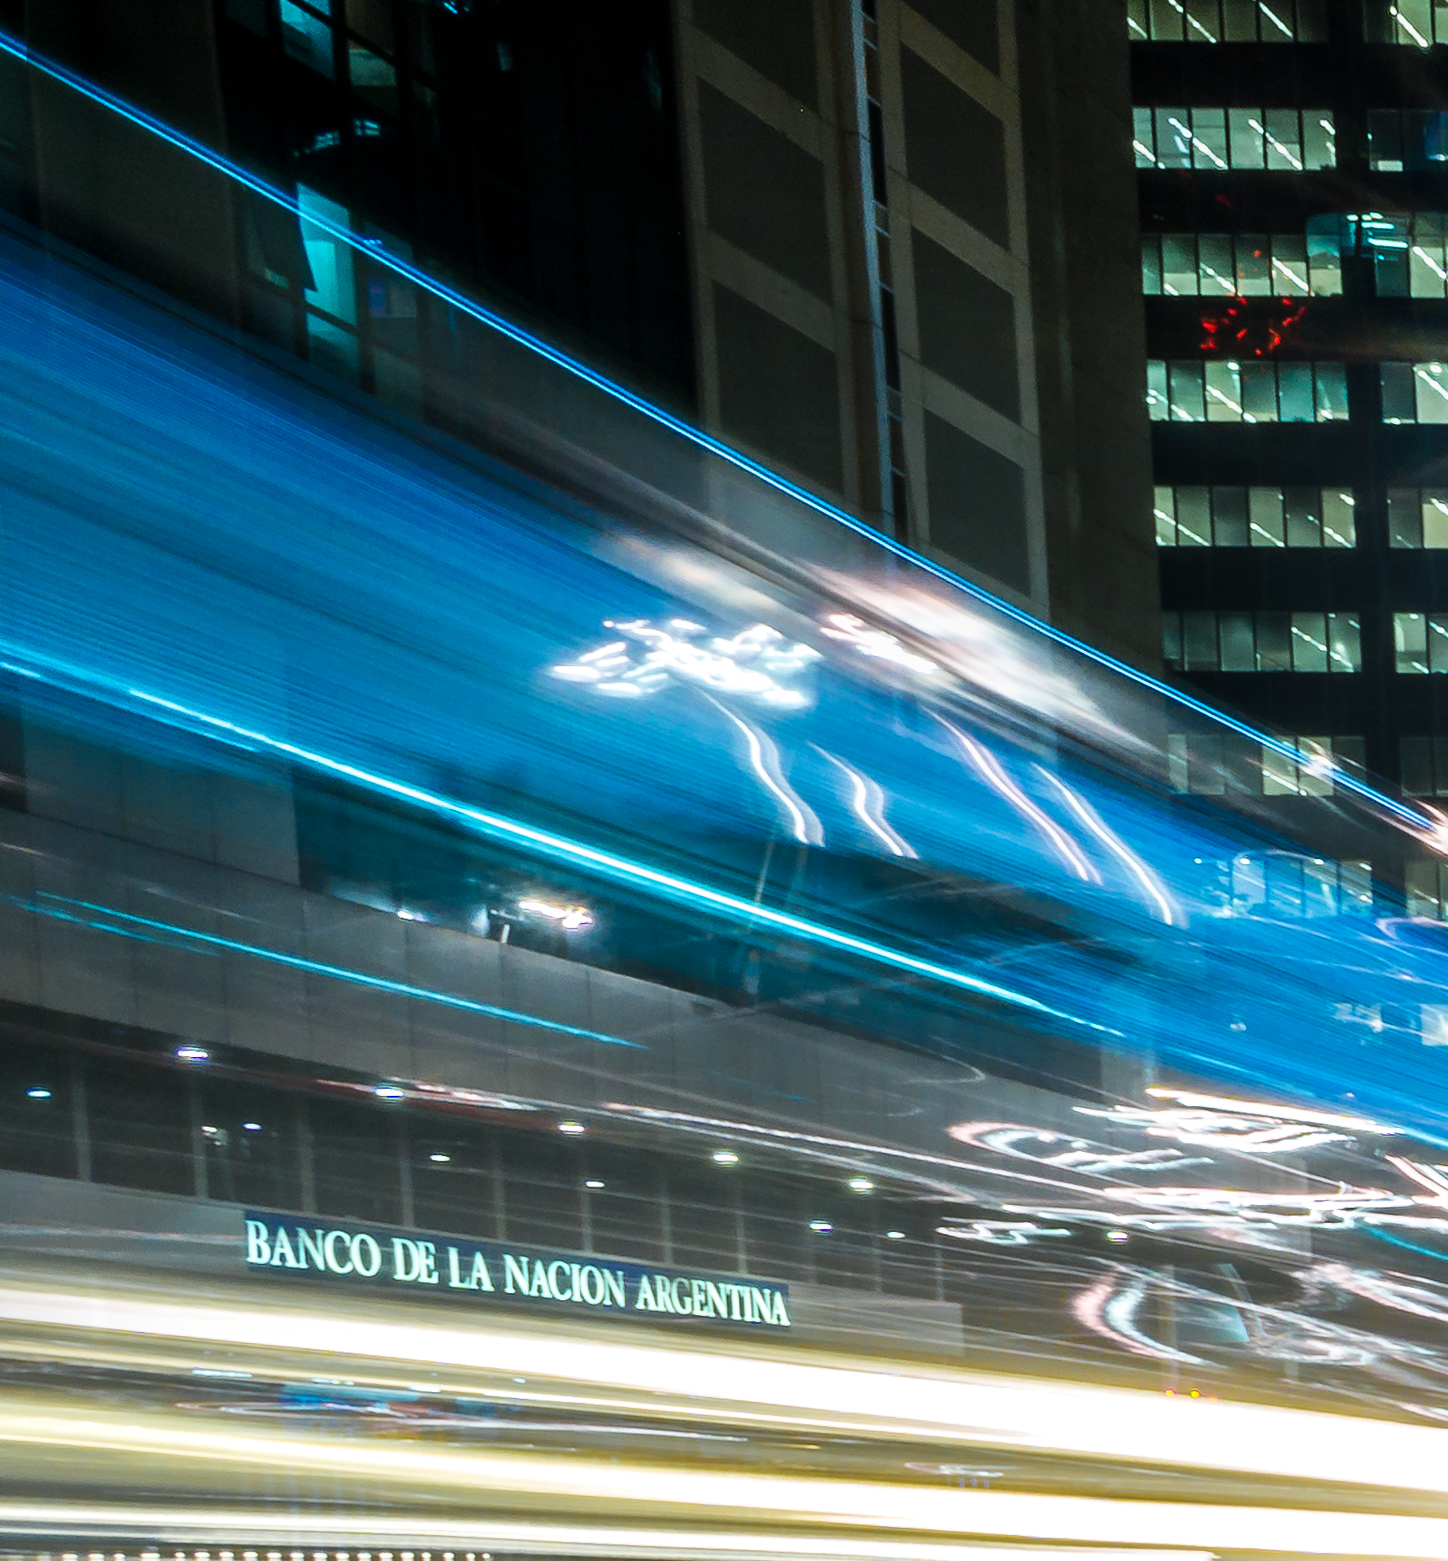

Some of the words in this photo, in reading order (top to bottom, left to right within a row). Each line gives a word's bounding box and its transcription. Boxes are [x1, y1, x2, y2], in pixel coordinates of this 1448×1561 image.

[245, 1219, 382, 1277] BANCO
[391, 1237, 439, 1285] DE
[447, 1246, 495, 1292] LA
[503, 1253, 626, 1308] NACION
[635, 1274, 792, 1326] ARGENTINA
